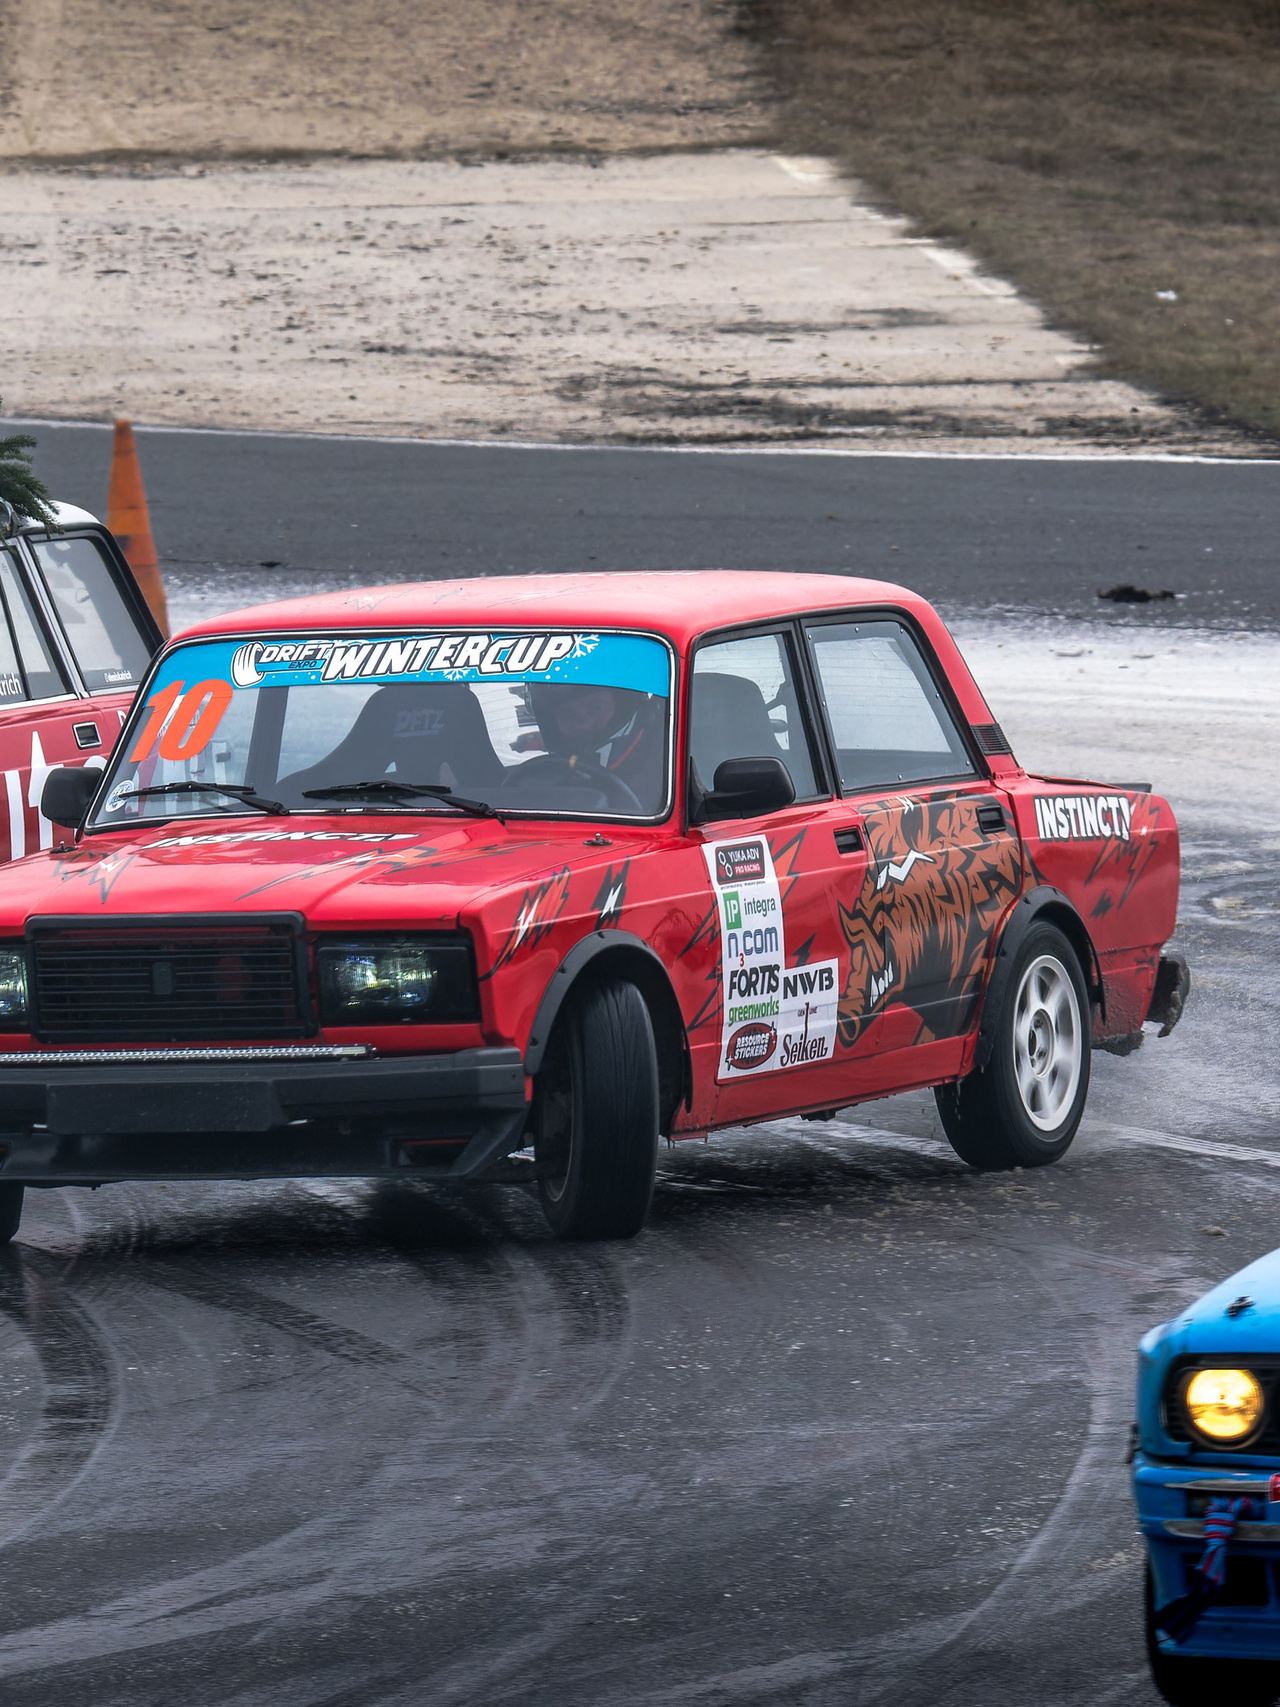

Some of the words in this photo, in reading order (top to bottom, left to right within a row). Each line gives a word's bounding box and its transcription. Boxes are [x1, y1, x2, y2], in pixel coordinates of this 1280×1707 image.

[259, 643, 335, 662] DRIFT
[287, 660, 317, 670] EXPO
[129, 679, 234, 764] 10
[728, 849, 747, 862] YUKA
[746, 847, 760, 860] ADV
[735, 865, 744, 873] PRO
[744, 863, 761, 872] RACING
[744, 898, 777, 917] integra
[728, 964, 780, 1000] FORTIS
[783, 967, 834, 1000] NWB
[728, 996, 780, 1027] greenworks
[736, 1033, 770, 1048] RESOURCE
[734, 1044, 768, 1059] STICKERS
